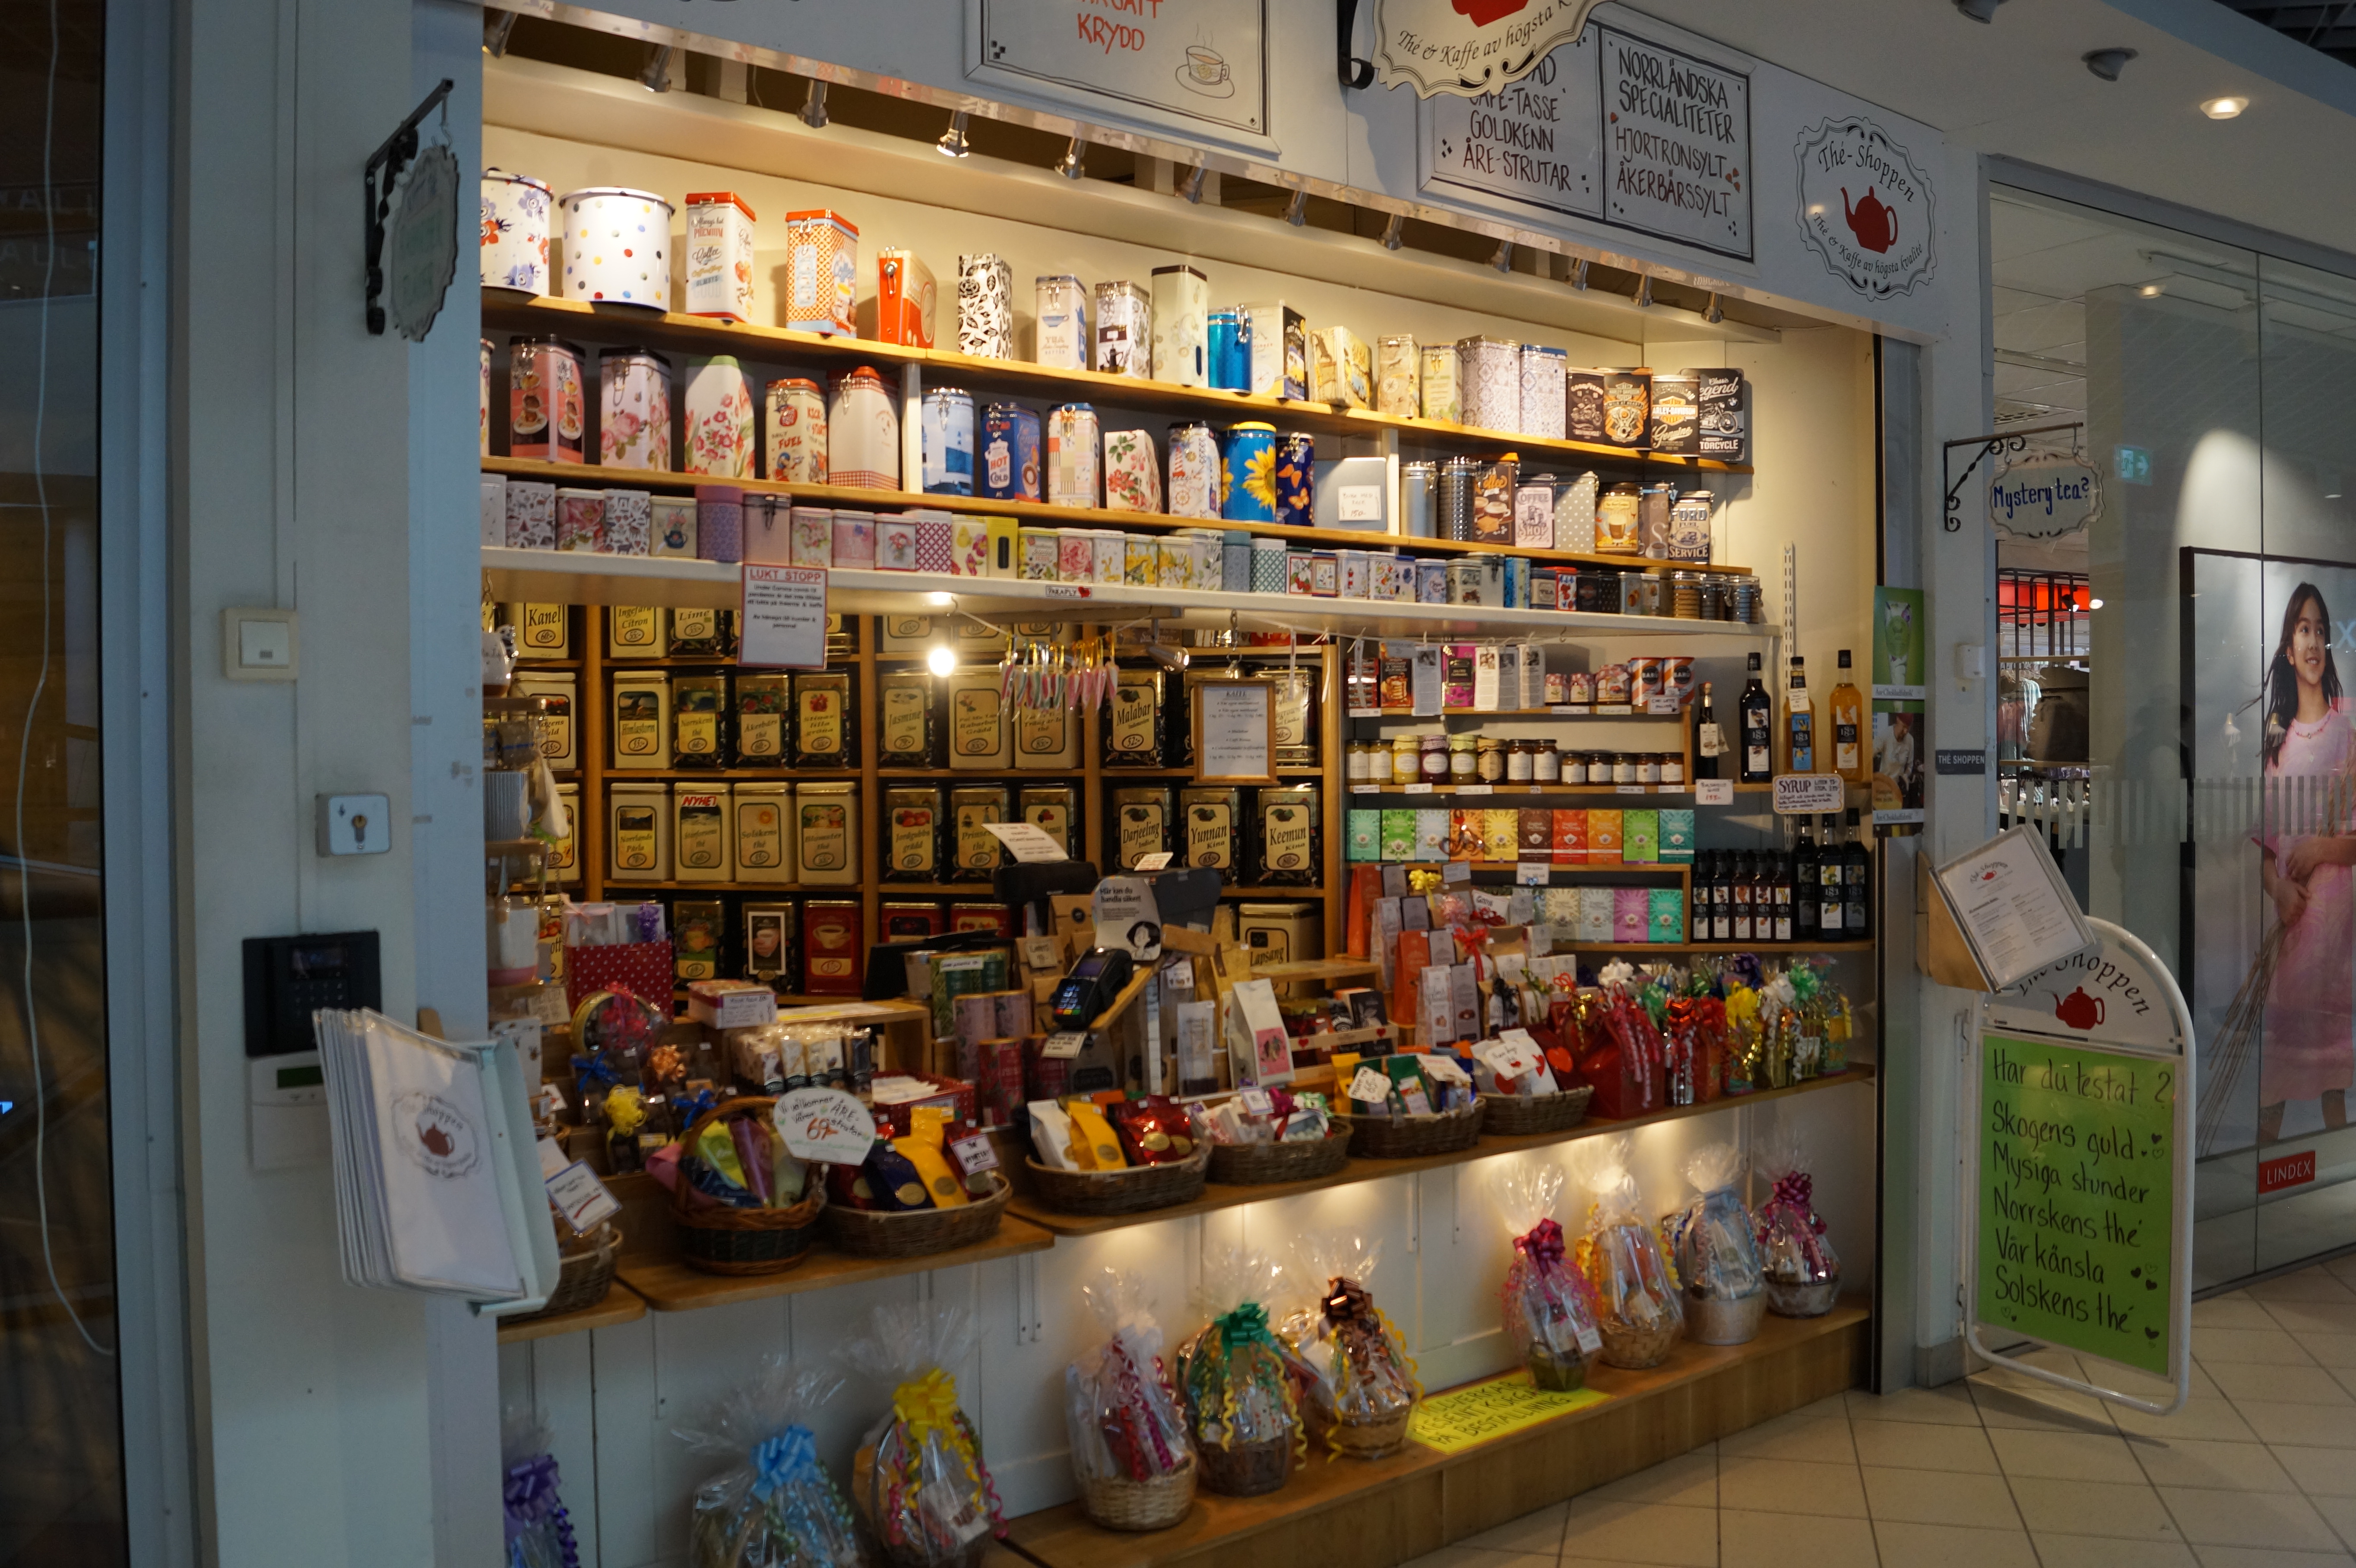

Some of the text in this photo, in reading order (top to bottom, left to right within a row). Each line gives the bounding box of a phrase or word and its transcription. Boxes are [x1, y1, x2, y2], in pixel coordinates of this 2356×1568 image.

[1077, 13, 1145, 54] KRYDD
[1397, 6, 1553, 70] Thé & Kaffe av högsta
[1618, 47, 1729, 109] NORRLÄNDSKA
[1619, 79, 1735, 144] SPECIALITETER
[1471, 110, 1553, 152] GOLDKENN
[1463, 137, 1572, 192] ÅRE-STRUTAR
[1616, 126, 1727, 179] HJORTRONSYLT
[1617, 161, 1732, 218] ÅKERBÄRSSYLT
[1814, 212, 1923, 279] Thé & Kaffe av högsta kvalité
[1699, 377, 1738, 402] egend
[1652, 407, 1696, 415] ARLEY-DAVIDSON
[778, 435, 802, 449] FUEL
[1700, 439, 1738, 449] TORCYCLE
[991, 456, 1008, 470] HOT
[1994, 476, 2090, 519] Mystery tea?
[1519, 523, 1549, 537] SHOP
[1669, 545, 1709, 558] SERVICE
[749, 569, 821, 582] LUKT STOPP
[528, 605, 561, 628] Kanel
[622, 617, 648, 629] Citron
[679, 609, 710, 621] Lime
[1116, 703, 1151, 727] Malabar
[1938, 754, 1985, 765] THE SHOPPEN
[1779, 779, 1811, 793] SYRUP
[682, 796, 717, 806] NYHET
[1123, 822, 1160, 845] Darjeeling
[1191, 825, 1227, 845] Yunnan
[1207, 841, 1225, 849] Kina
[1270, 827, 1306, 846] Keemun
[1250, 947, 1284, 967] Lapsang
[1993, 1048, 2025, 1084] Har
[2041, 1059, 2068, 1093] du
[2077, 1061, 2139, 1105] testat
[1992, 1100, 2076, 1152] Skogens
[1994, 1140, 2150, 1203] Mysiga stunder
[2267, 1159, 2311, 1185] LINDEX
[1994, 1180, 2143, 1248] Norrskens thé
[2035, 1233, 2104, 1285] känsla
[1995, 1265, 2131, 1333] Solskens thé
